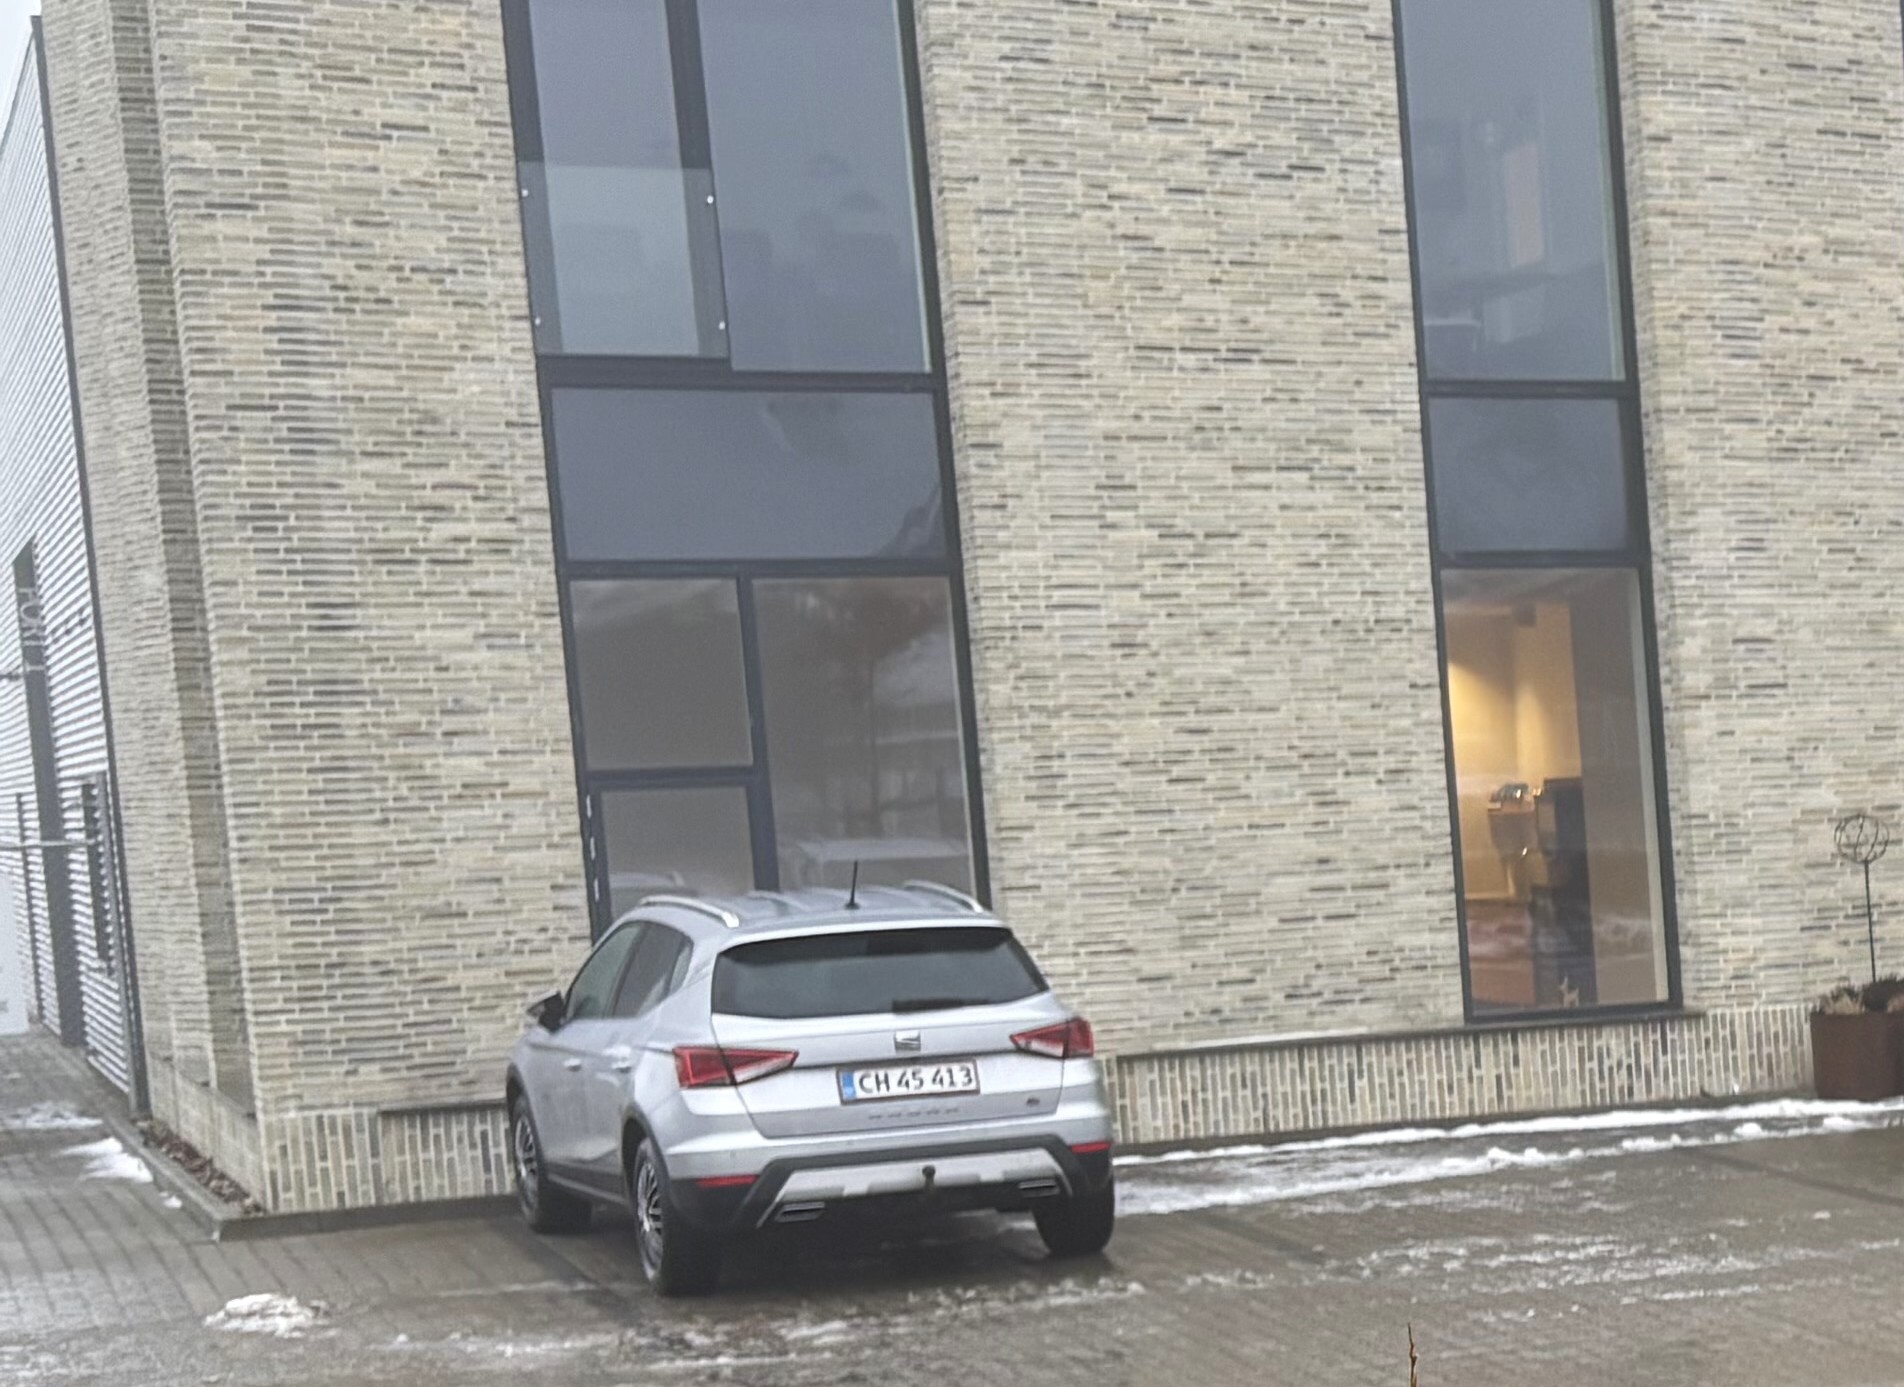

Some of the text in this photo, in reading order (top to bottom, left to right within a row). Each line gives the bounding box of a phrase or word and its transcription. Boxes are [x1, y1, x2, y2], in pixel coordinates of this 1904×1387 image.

[858, 1065, 973, 1094] CH 45 413
